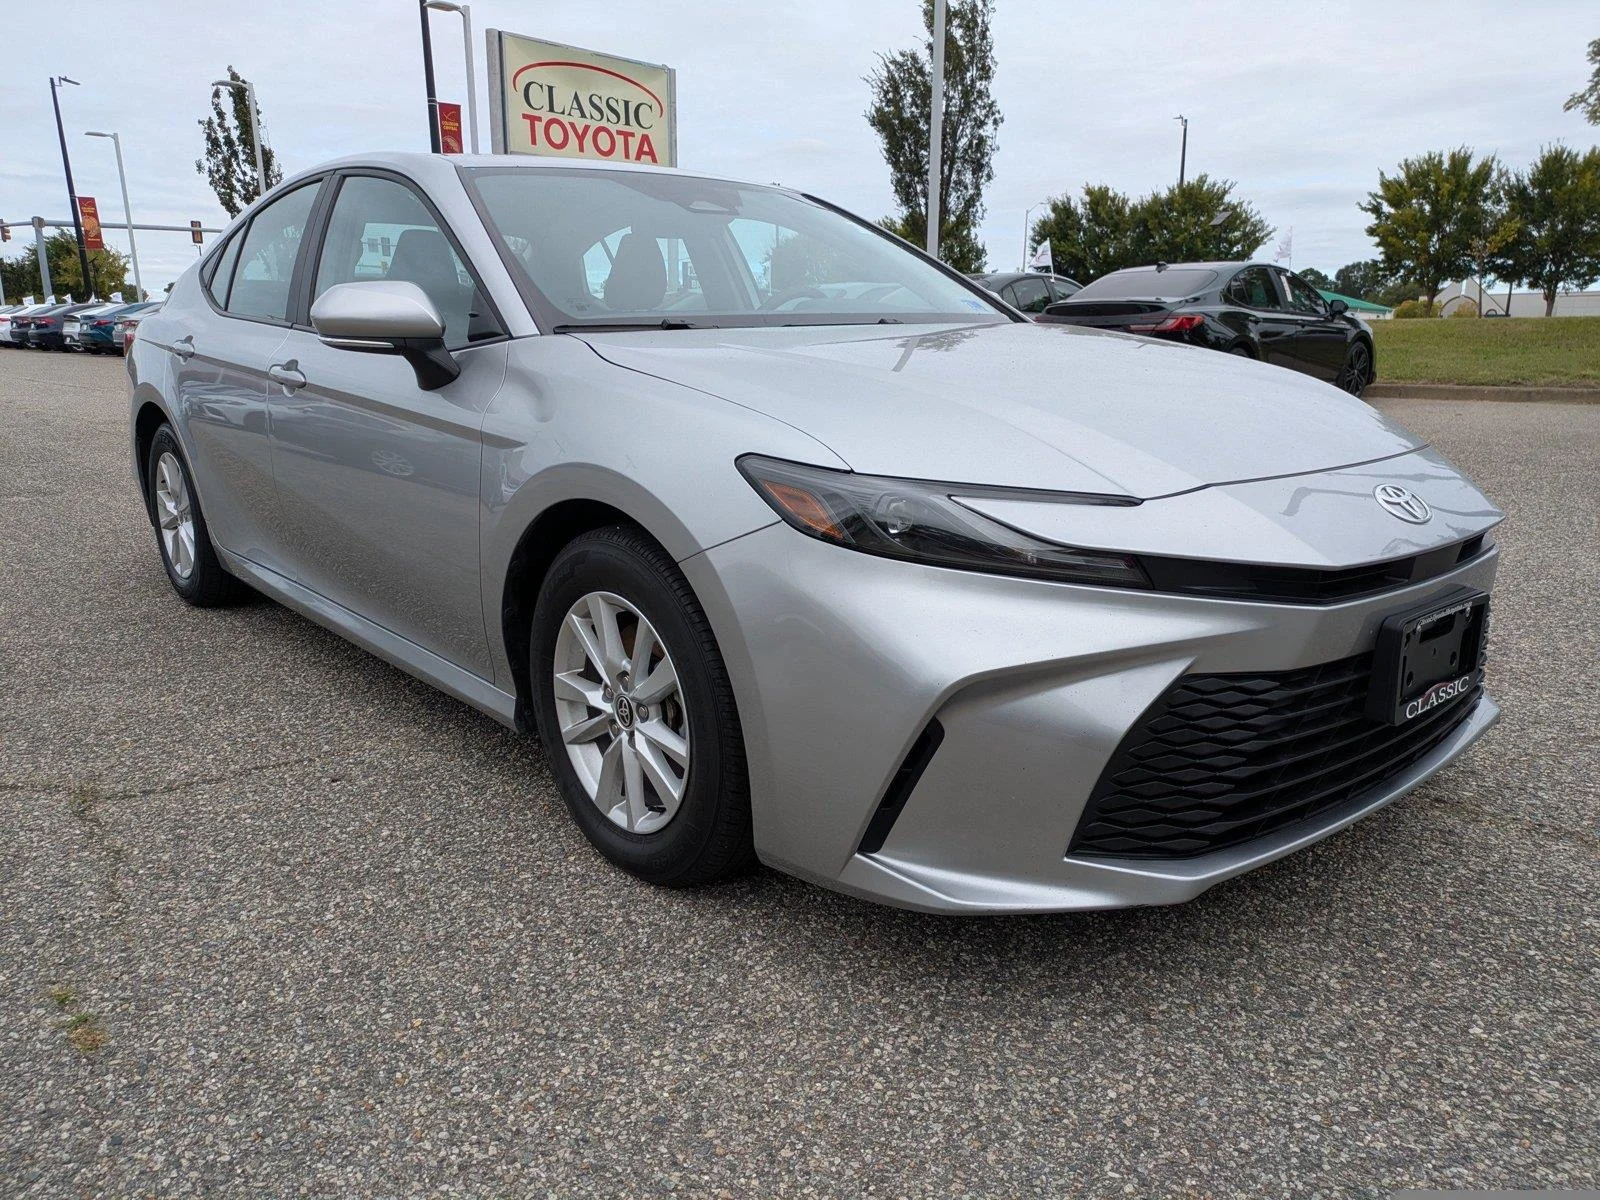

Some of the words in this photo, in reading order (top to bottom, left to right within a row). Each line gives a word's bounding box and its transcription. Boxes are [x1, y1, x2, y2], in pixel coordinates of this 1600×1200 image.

[523, 81, 653, 130] CLASSIC
[522, 113, 658, 164] TOYOTA
[1405, 676, 1469, 719] CLASSIC
